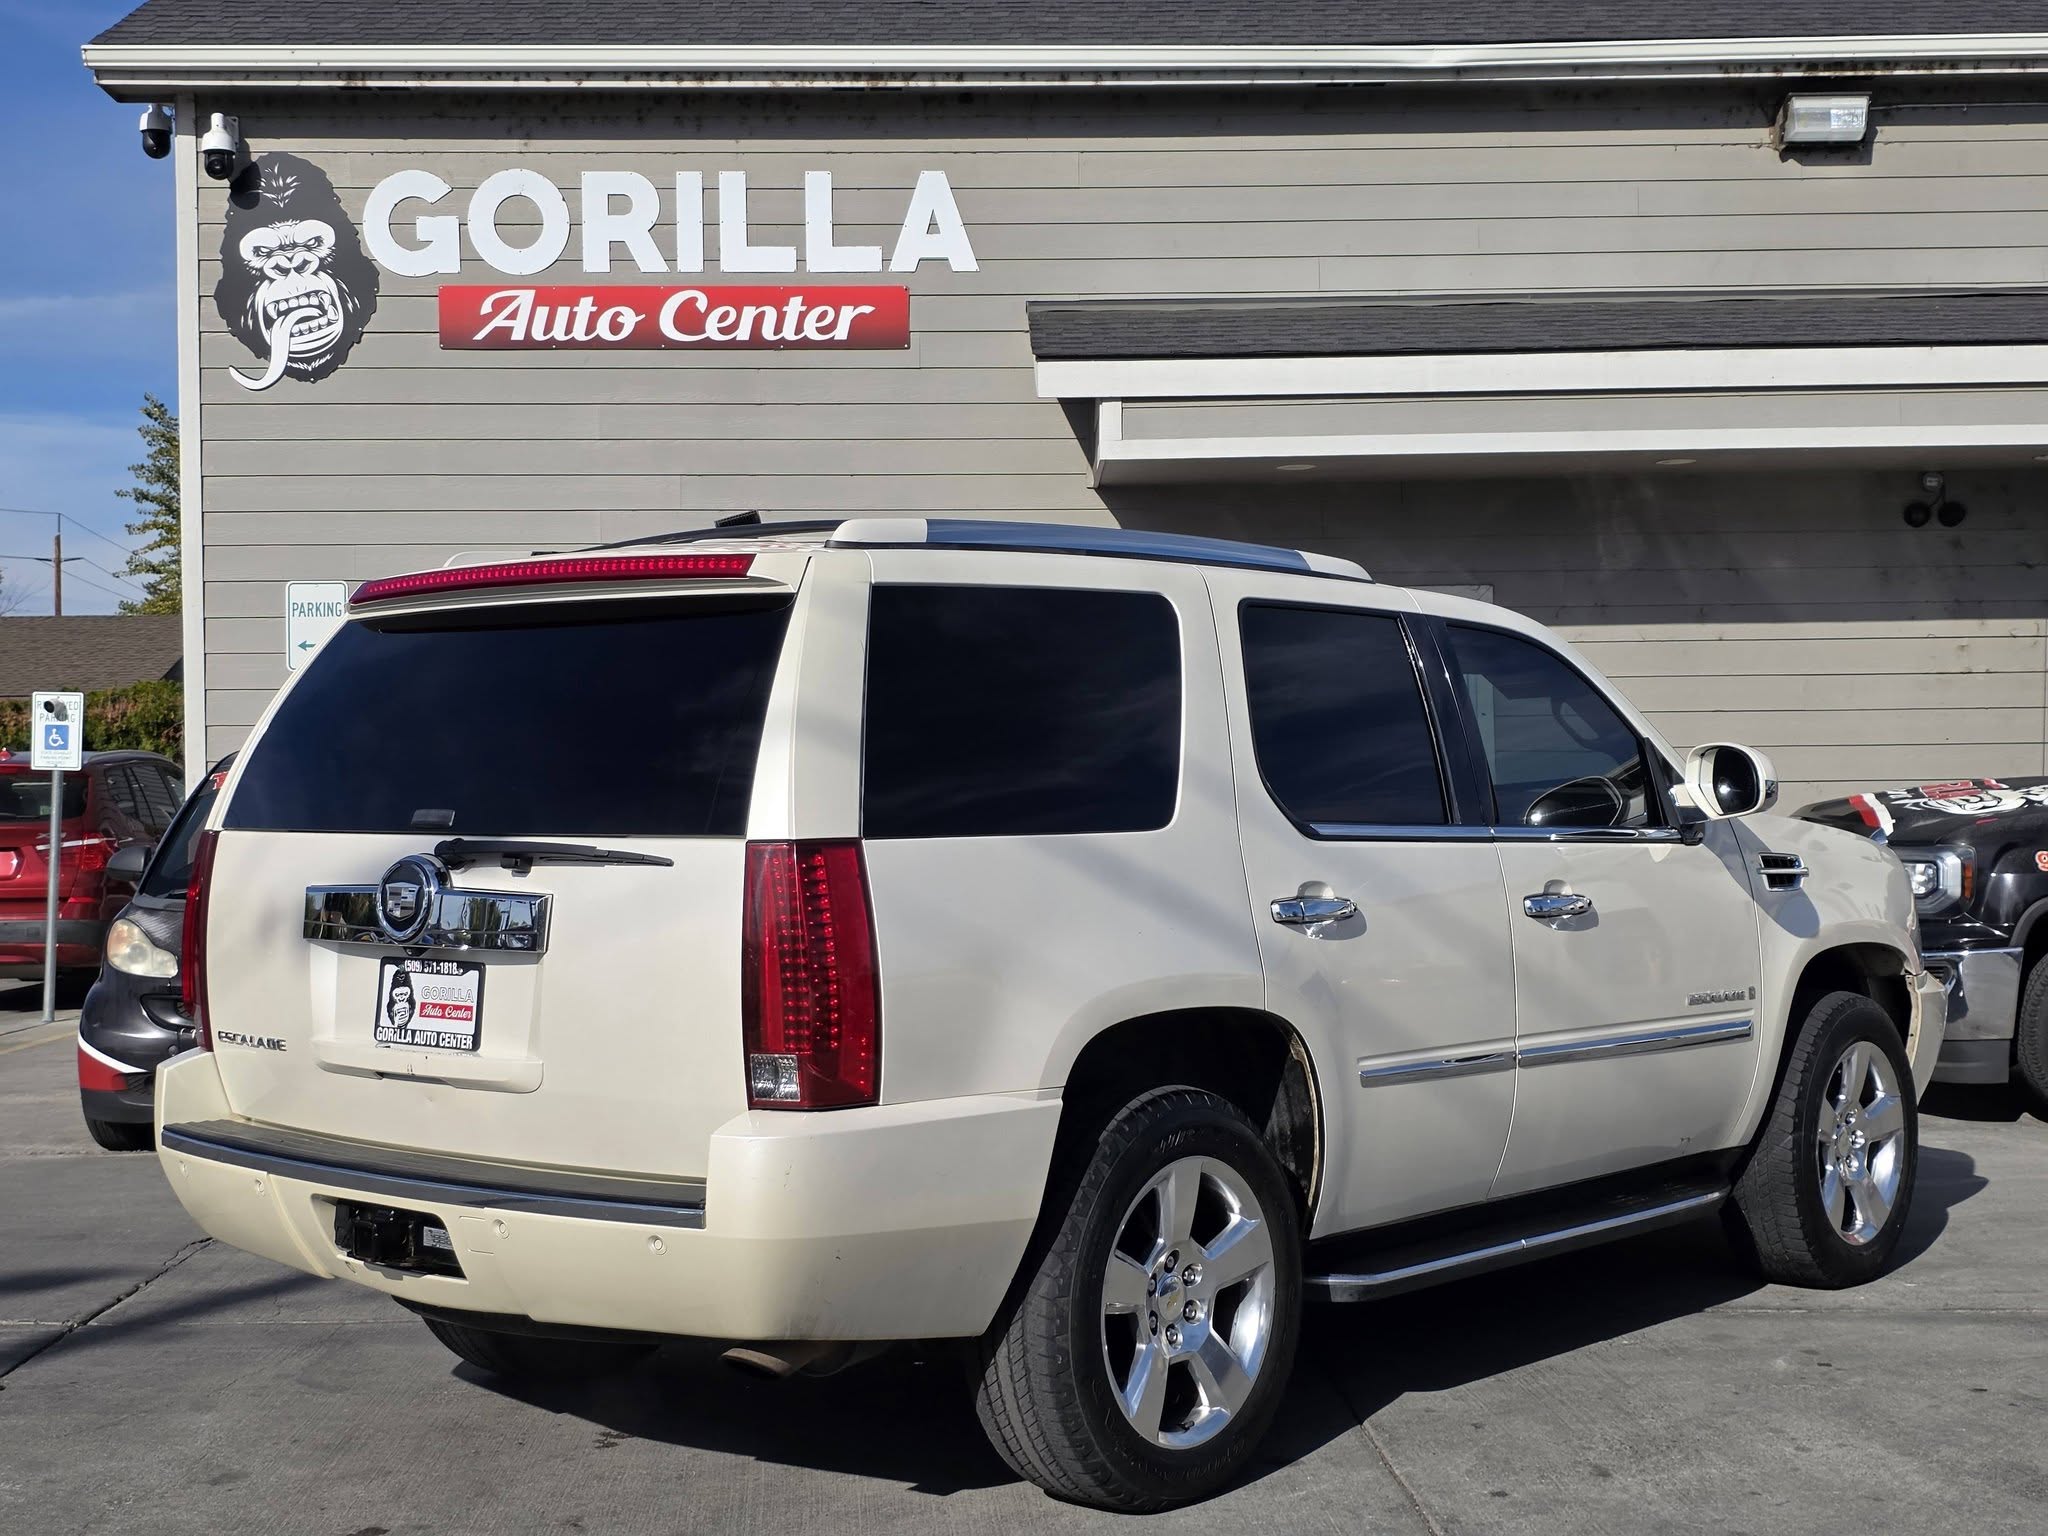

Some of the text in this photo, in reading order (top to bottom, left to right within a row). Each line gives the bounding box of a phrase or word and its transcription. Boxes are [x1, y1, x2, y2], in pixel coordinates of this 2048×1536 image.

[362, 168, 979, 275] GORILLA
[472, 289, 876, 341] Auto Center
[292, 602, 342, 617] PARKING
[404, 959, 458, 975] (509) 571-1818
[421, 985, 474, 1003] GORILLA
[421, 1004, 472, 1019] Auto Center
[376, 1026, 473, 1050] GORILLA AUTO CENTER
